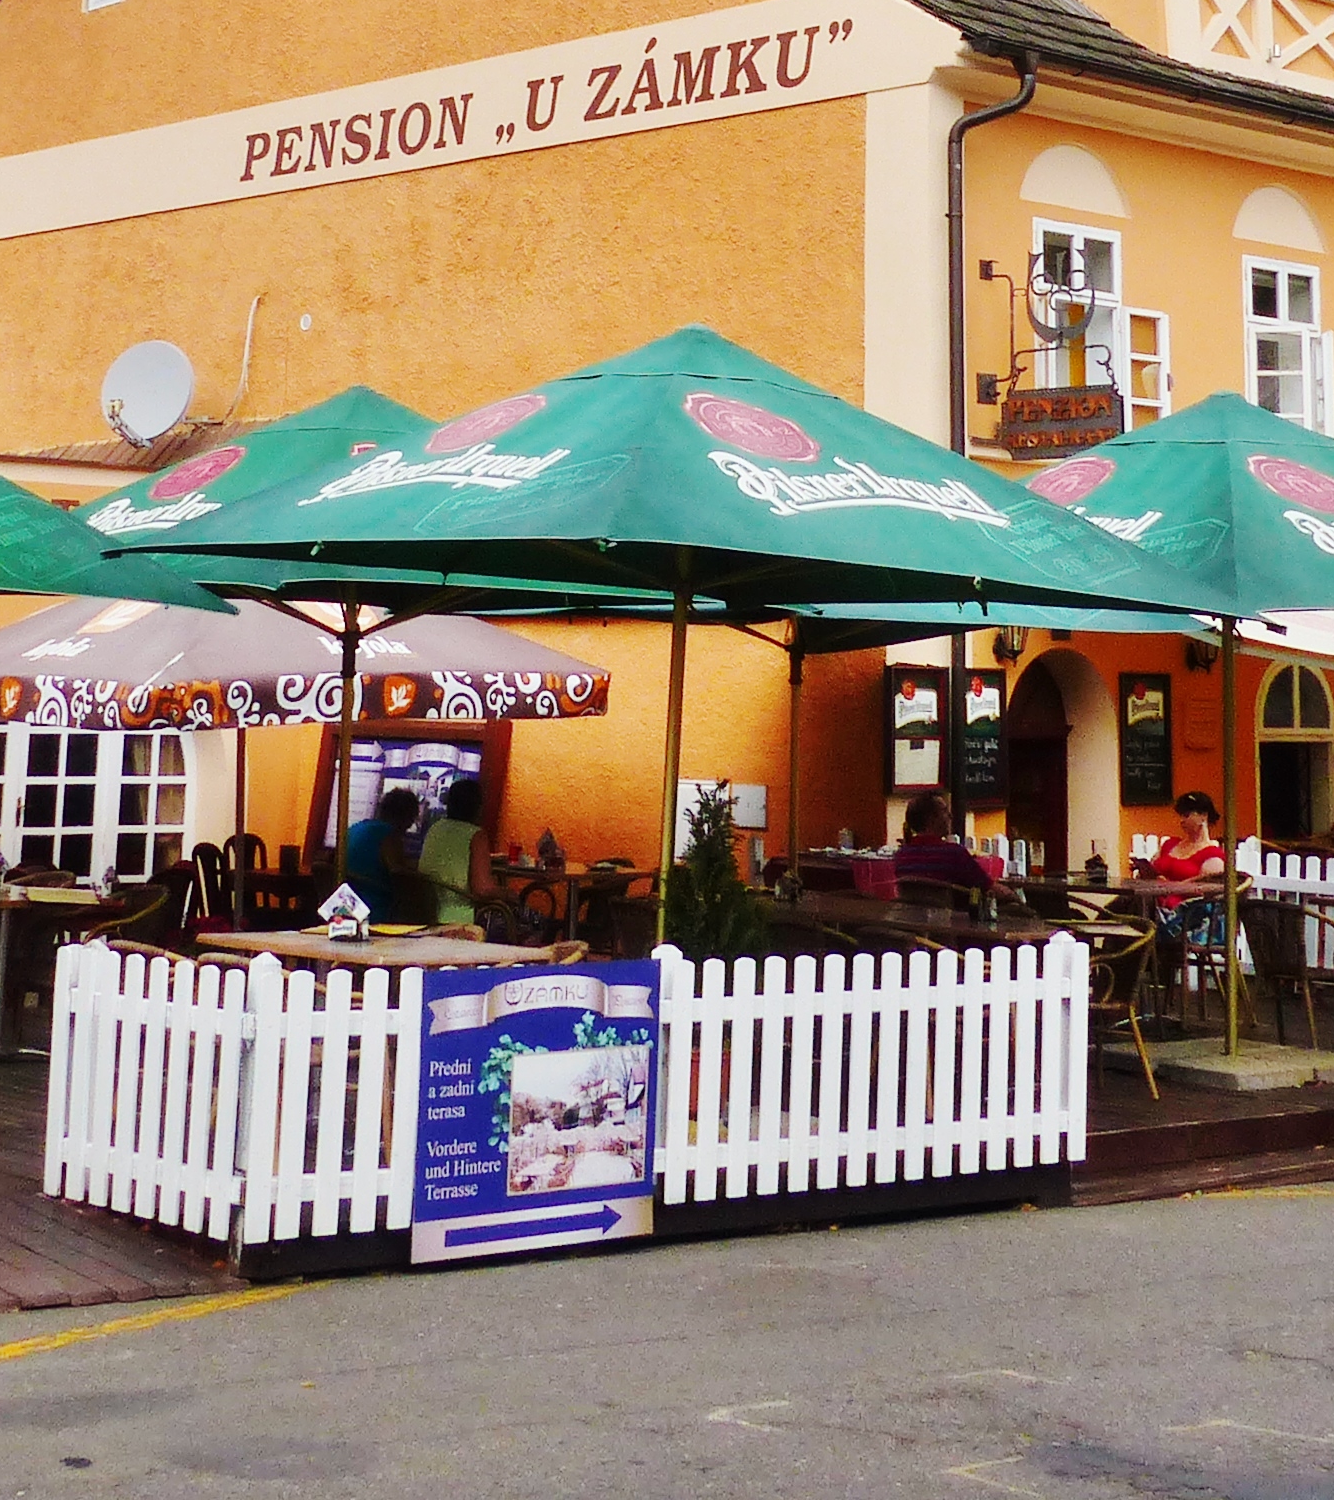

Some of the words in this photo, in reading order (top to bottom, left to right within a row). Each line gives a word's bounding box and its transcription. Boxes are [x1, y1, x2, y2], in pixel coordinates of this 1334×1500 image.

[239, 93, 474, 182] PENSION
[297, 450, 457, 506] Pilsner
[442, 442, 571, 488] Urquell
[707, 451, 860, 516] Pilsner
[834, 457, 1011, 525] Urquell
[429, 1058, 472, 1077] Přední
[428, 1088, 436, 1099] a
[439, 1080, 474, 1098] zadní
[427, 1106, 466, 1120] terasa
[426, 1139, 477, 1157] Vordere
[425, 1160, 451, 1179] und
[454, 1158, 502, 1176] Hintere
[425, 1181, 478, 1201] Terrasse
